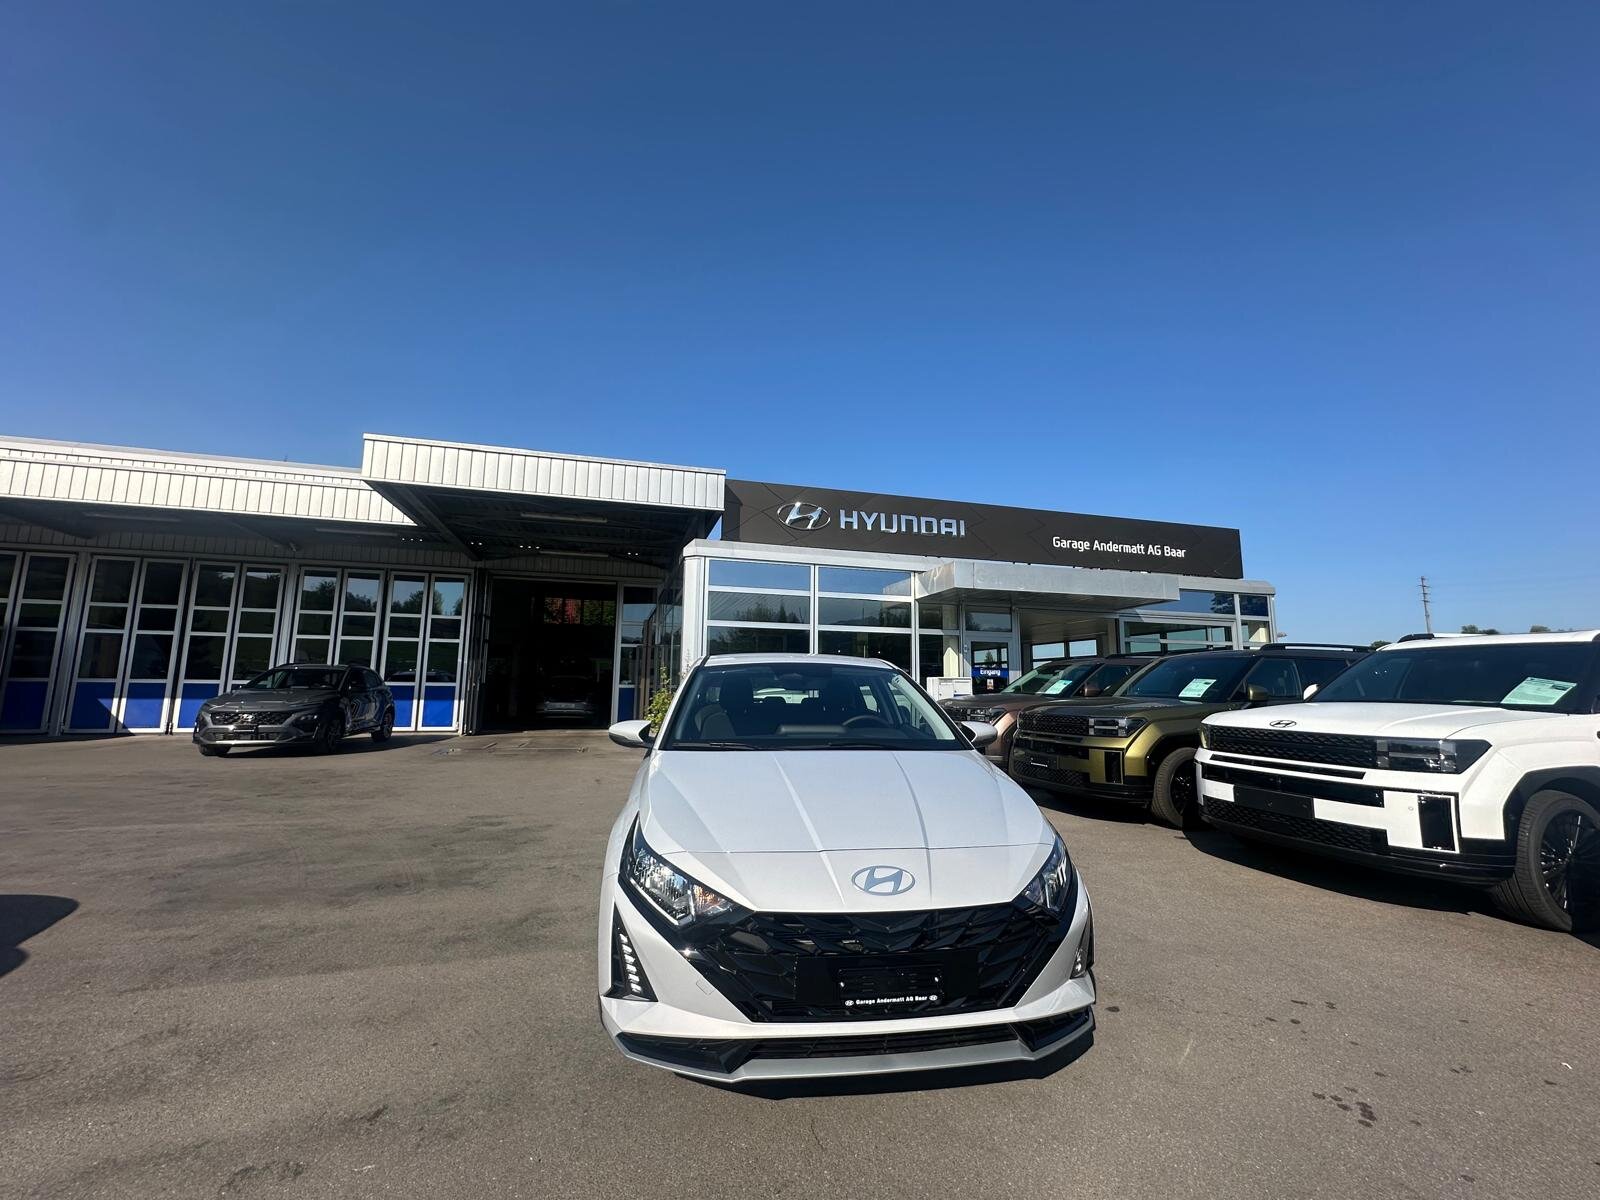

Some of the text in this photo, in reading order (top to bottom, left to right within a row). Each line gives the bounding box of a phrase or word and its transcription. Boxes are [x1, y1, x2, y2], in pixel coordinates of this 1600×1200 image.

[840, 509, 965, 536] HYUNDAI
[1053, 536, 1186, 557] Garage Andermatt AG Baar
